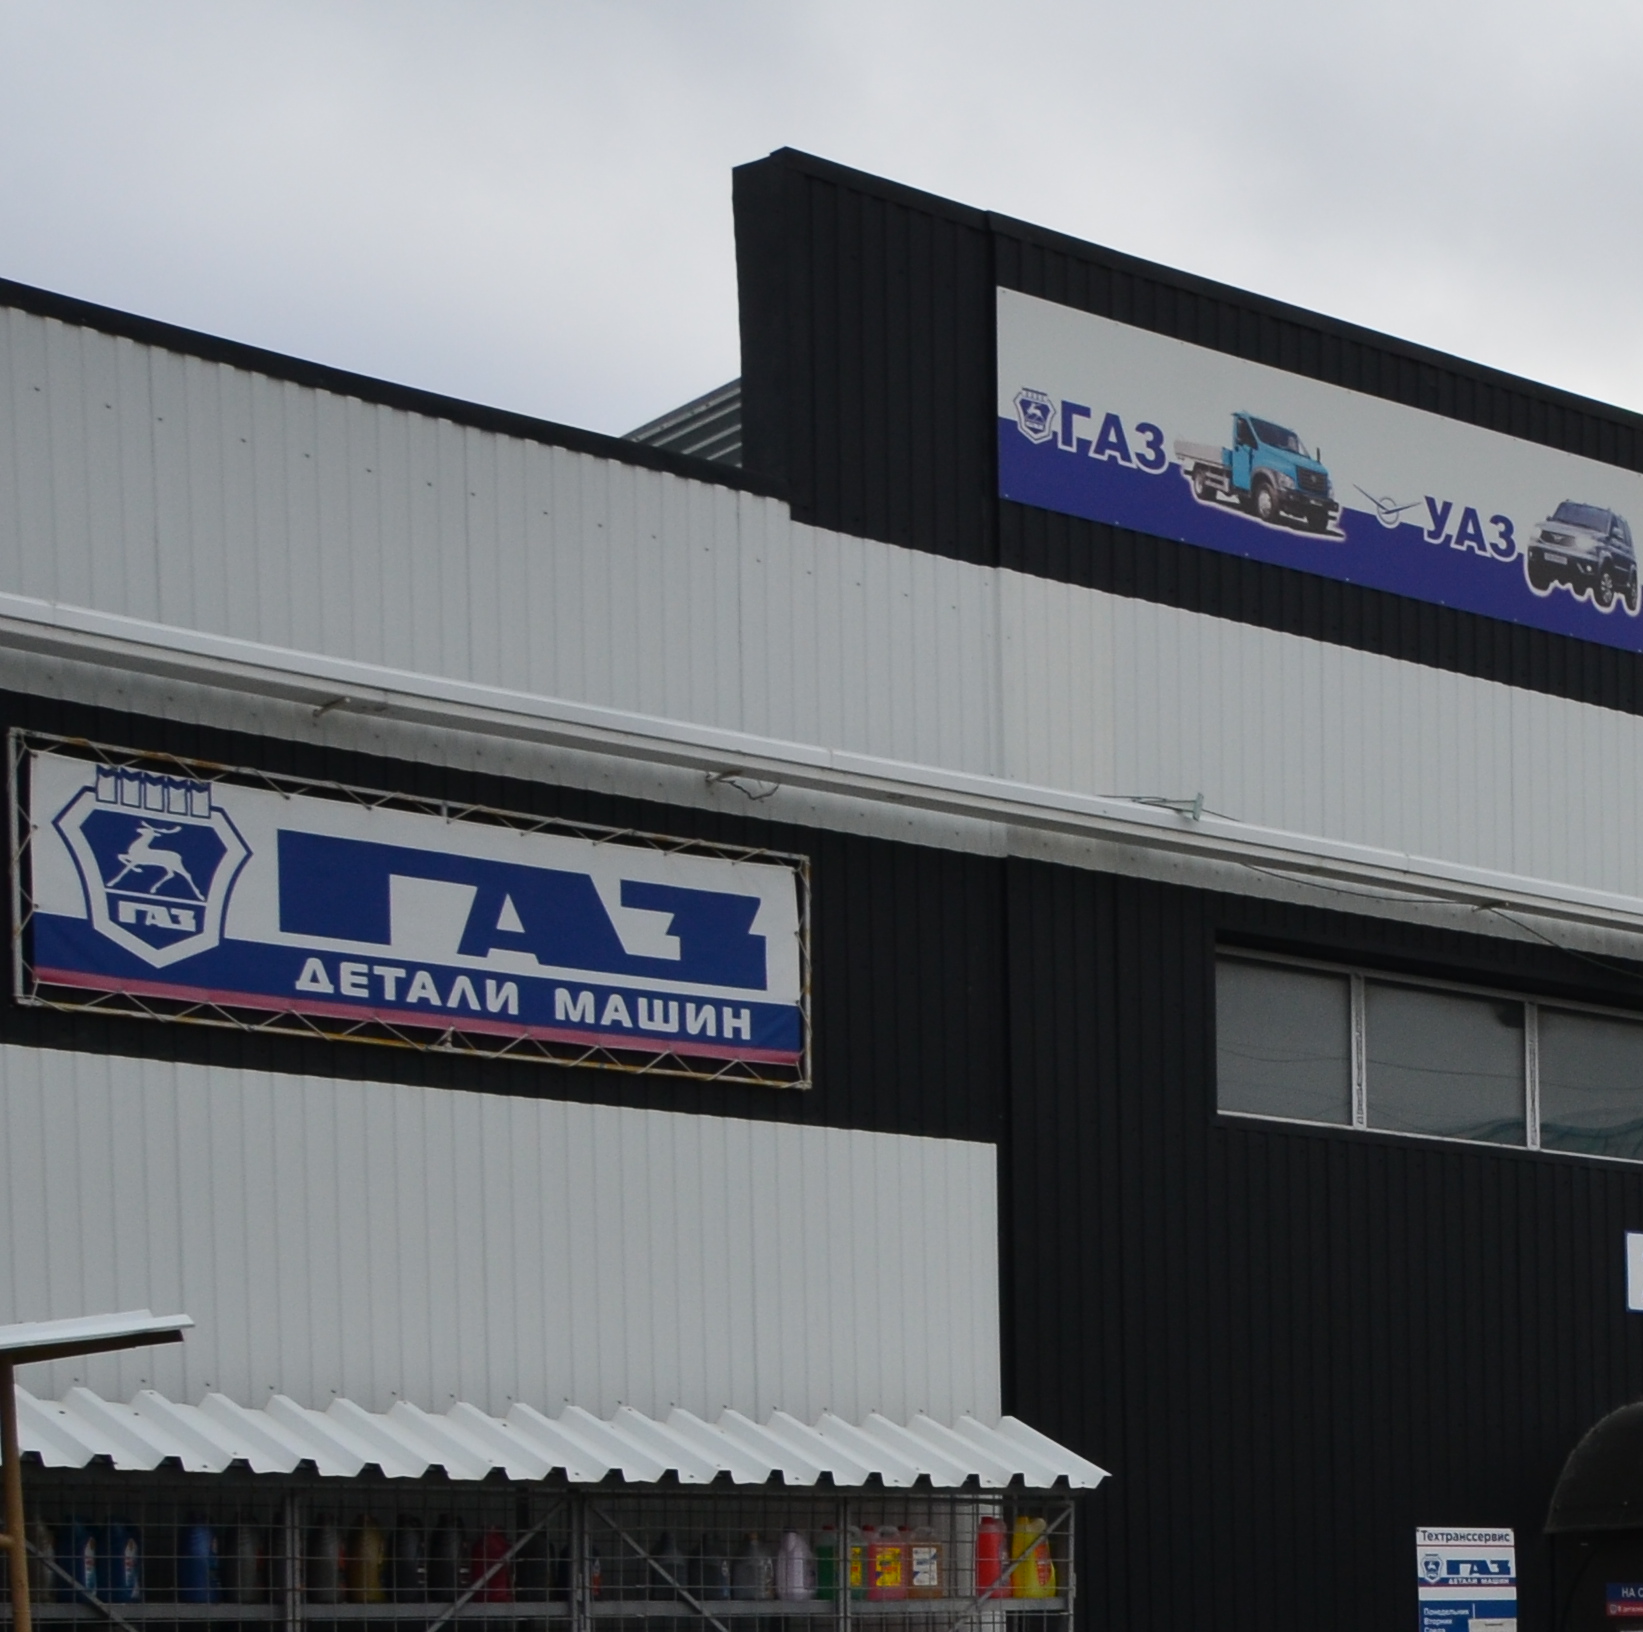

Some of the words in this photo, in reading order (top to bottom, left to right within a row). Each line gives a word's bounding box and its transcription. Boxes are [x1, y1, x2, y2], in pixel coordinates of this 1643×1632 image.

[1059, 400, 1165, 473] ГАЗ
[1424, 495, 1516, 560] УАЗ
[118, 901, 196, 931] ГАЗ
[277, 828, 767, 990] ГАЗ
[295, 957, 519, 1015] ДЕТАЛИ
[554, 994, 751, 1040] МАШИН
[1421, 1530, 1510, 1543] Техтранссервис
[1446, 1560, 1511, 1575] ГАЗ
[1622, 1587, 1635, 1598] НА
